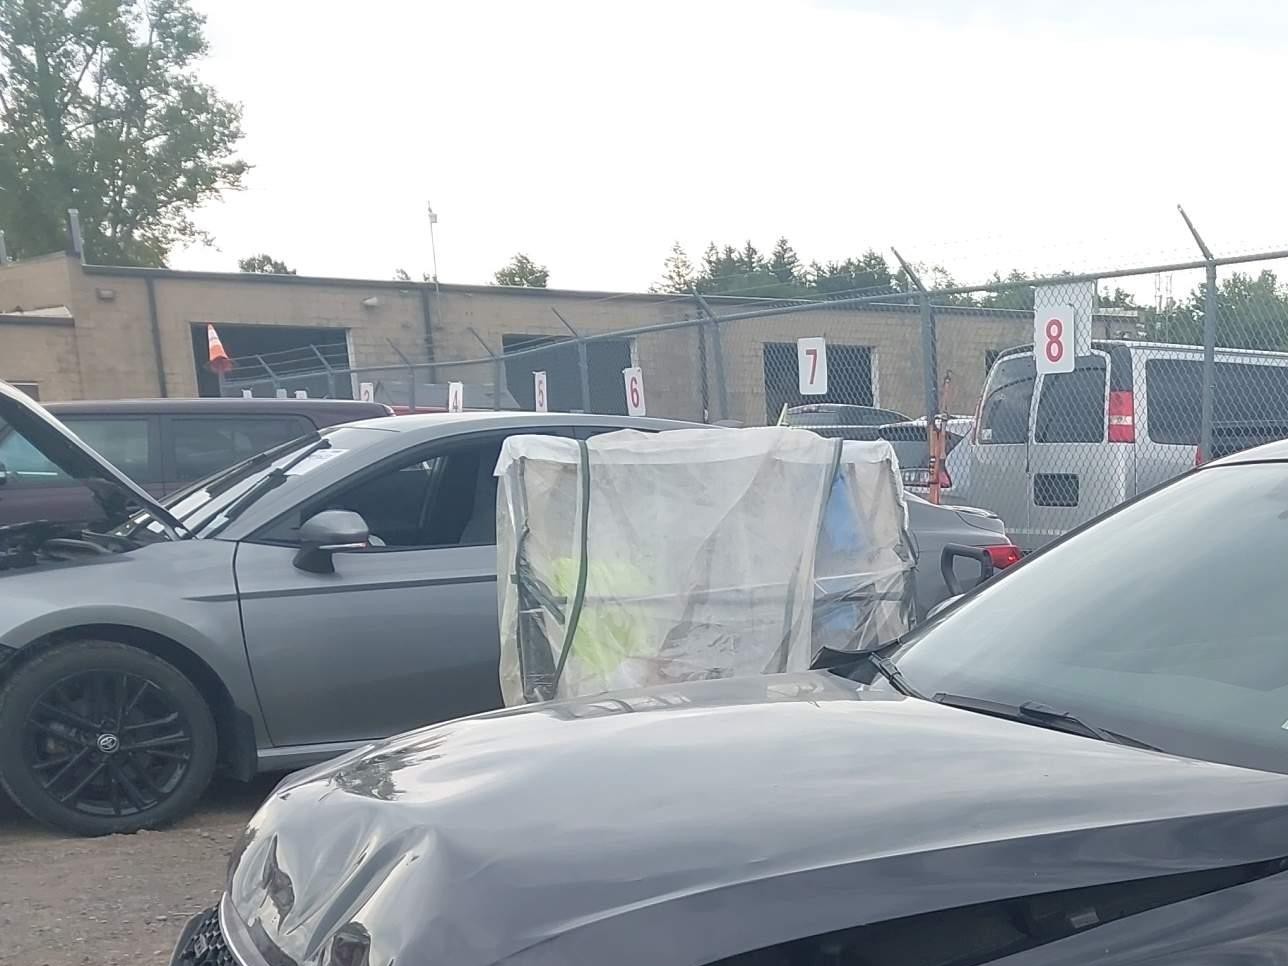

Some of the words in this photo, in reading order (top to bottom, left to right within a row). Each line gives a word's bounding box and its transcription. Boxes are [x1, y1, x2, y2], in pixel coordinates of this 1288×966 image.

[1045, 318, 1063, 362] 8
[805, 348, 817, 385] 7
[452, 389, 459, 412] 4
[537, 379, 544, 408] 5
[630, 376, 640, 408] 6
